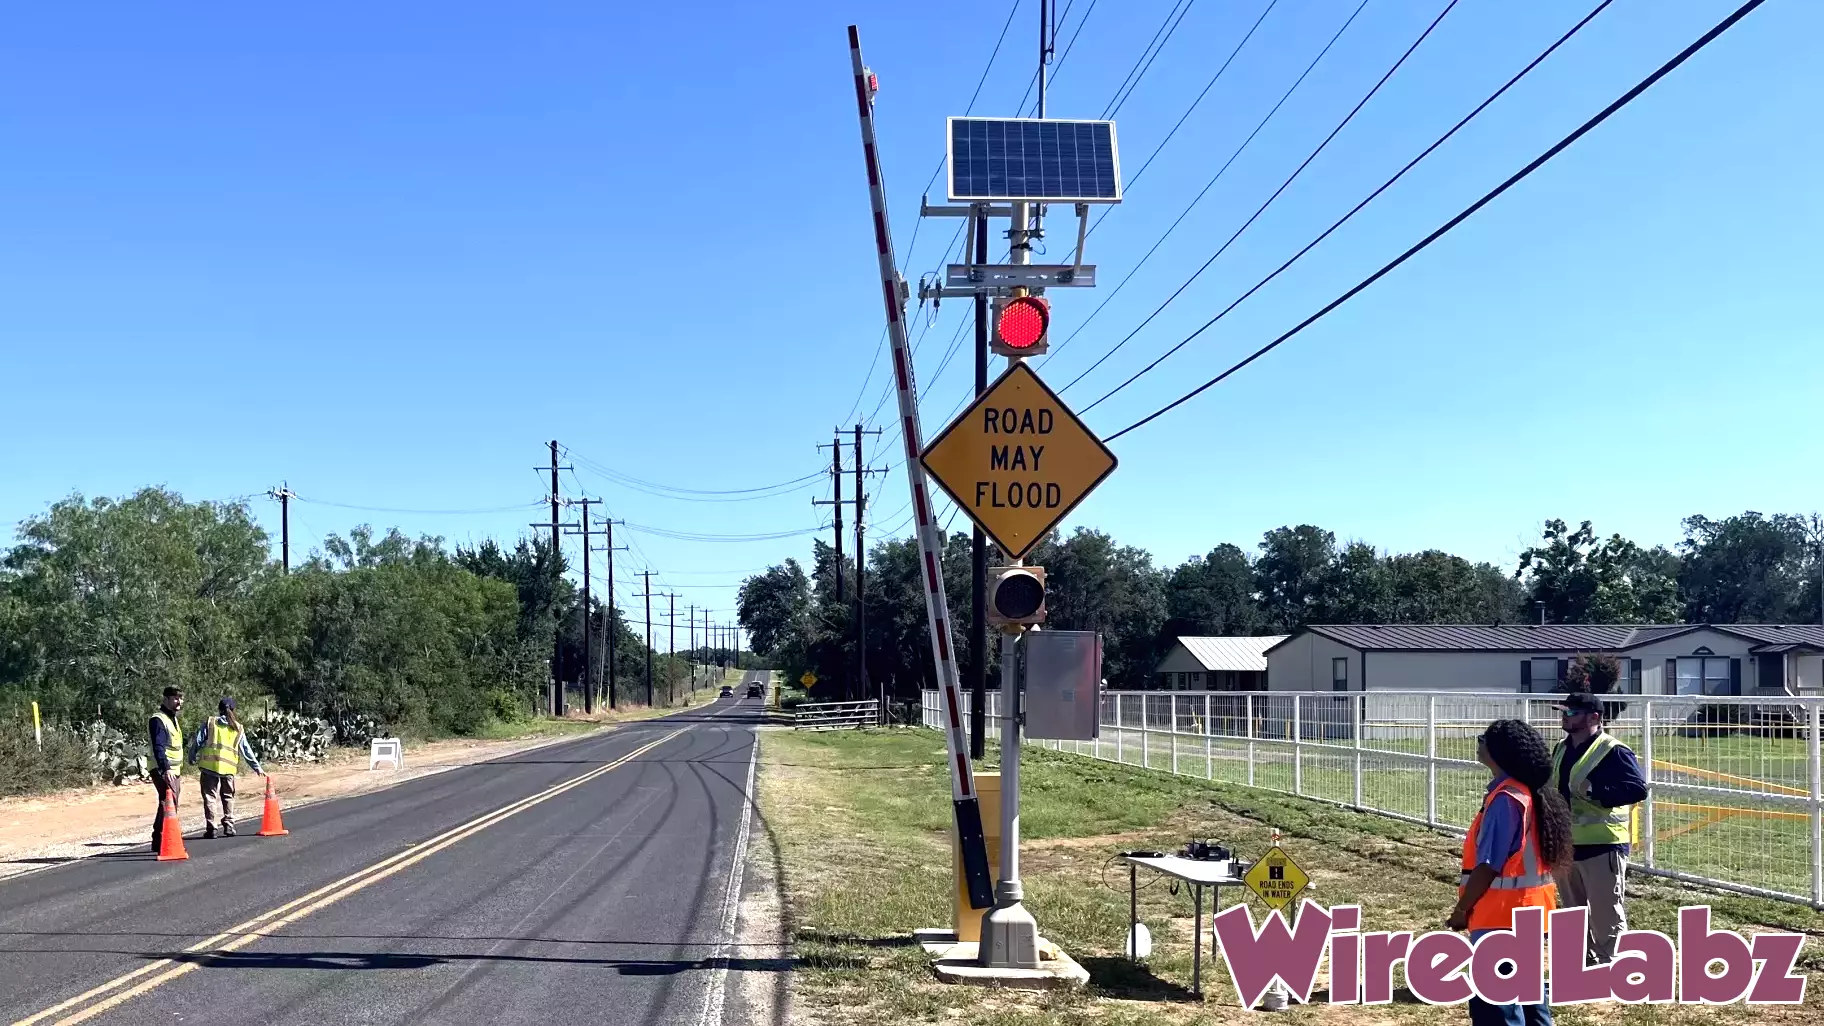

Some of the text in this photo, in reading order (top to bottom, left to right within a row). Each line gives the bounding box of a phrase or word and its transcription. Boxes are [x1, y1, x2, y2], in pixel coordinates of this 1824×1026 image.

[984, 408, 1053, 434] ROAD
[991, 445, 1044, 471] MAY
[976, 482, 1061, 508] FLOOD
[1260, 881, 1294, 889] ROAD ENDS
[1263, 890, 1291, 898] IN WATER
